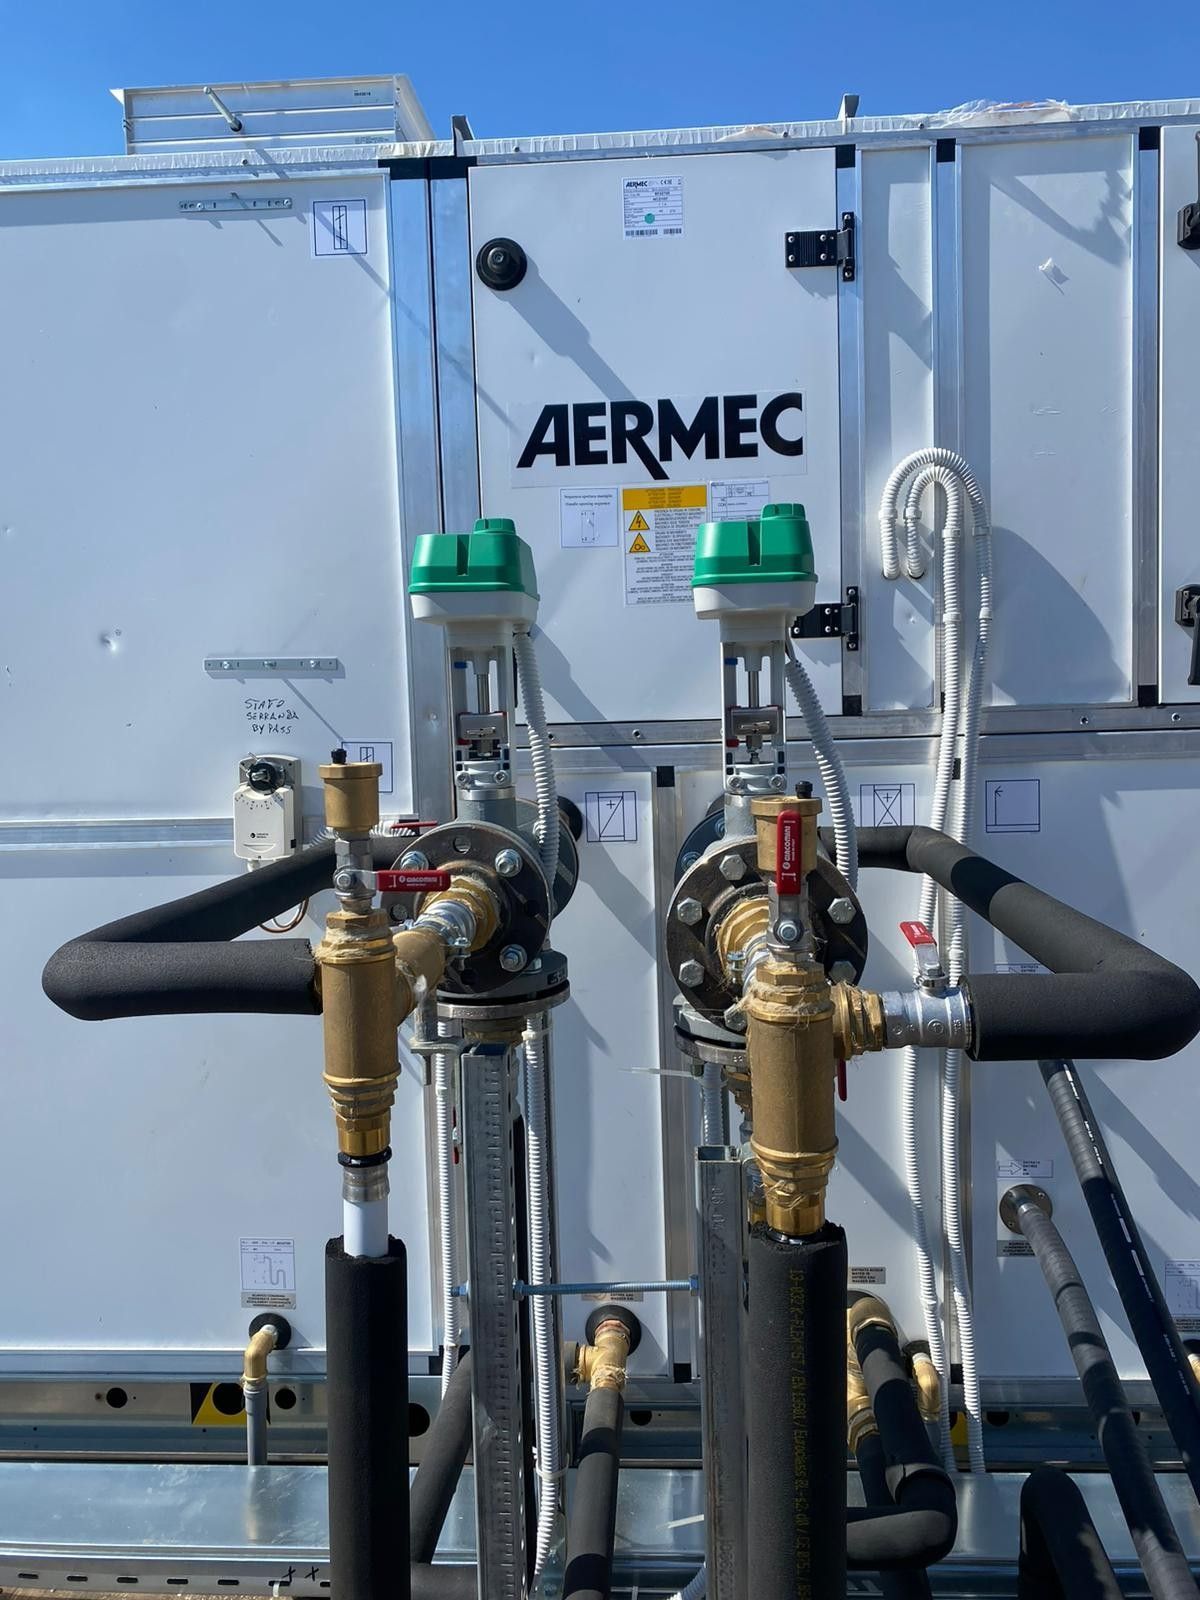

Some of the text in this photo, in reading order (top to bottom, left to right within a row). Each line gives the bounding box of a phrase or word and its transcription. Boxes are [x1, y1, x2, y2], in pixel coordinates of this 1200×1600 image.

[625, 180, 648, 189] AERMEC
[516, 392, 804, 480] AERMEC
[244, 698, 286, 709] STATO
[246, 709, 300, 721] SERRANDA
[252, 723, 293, 735] BY PASS
